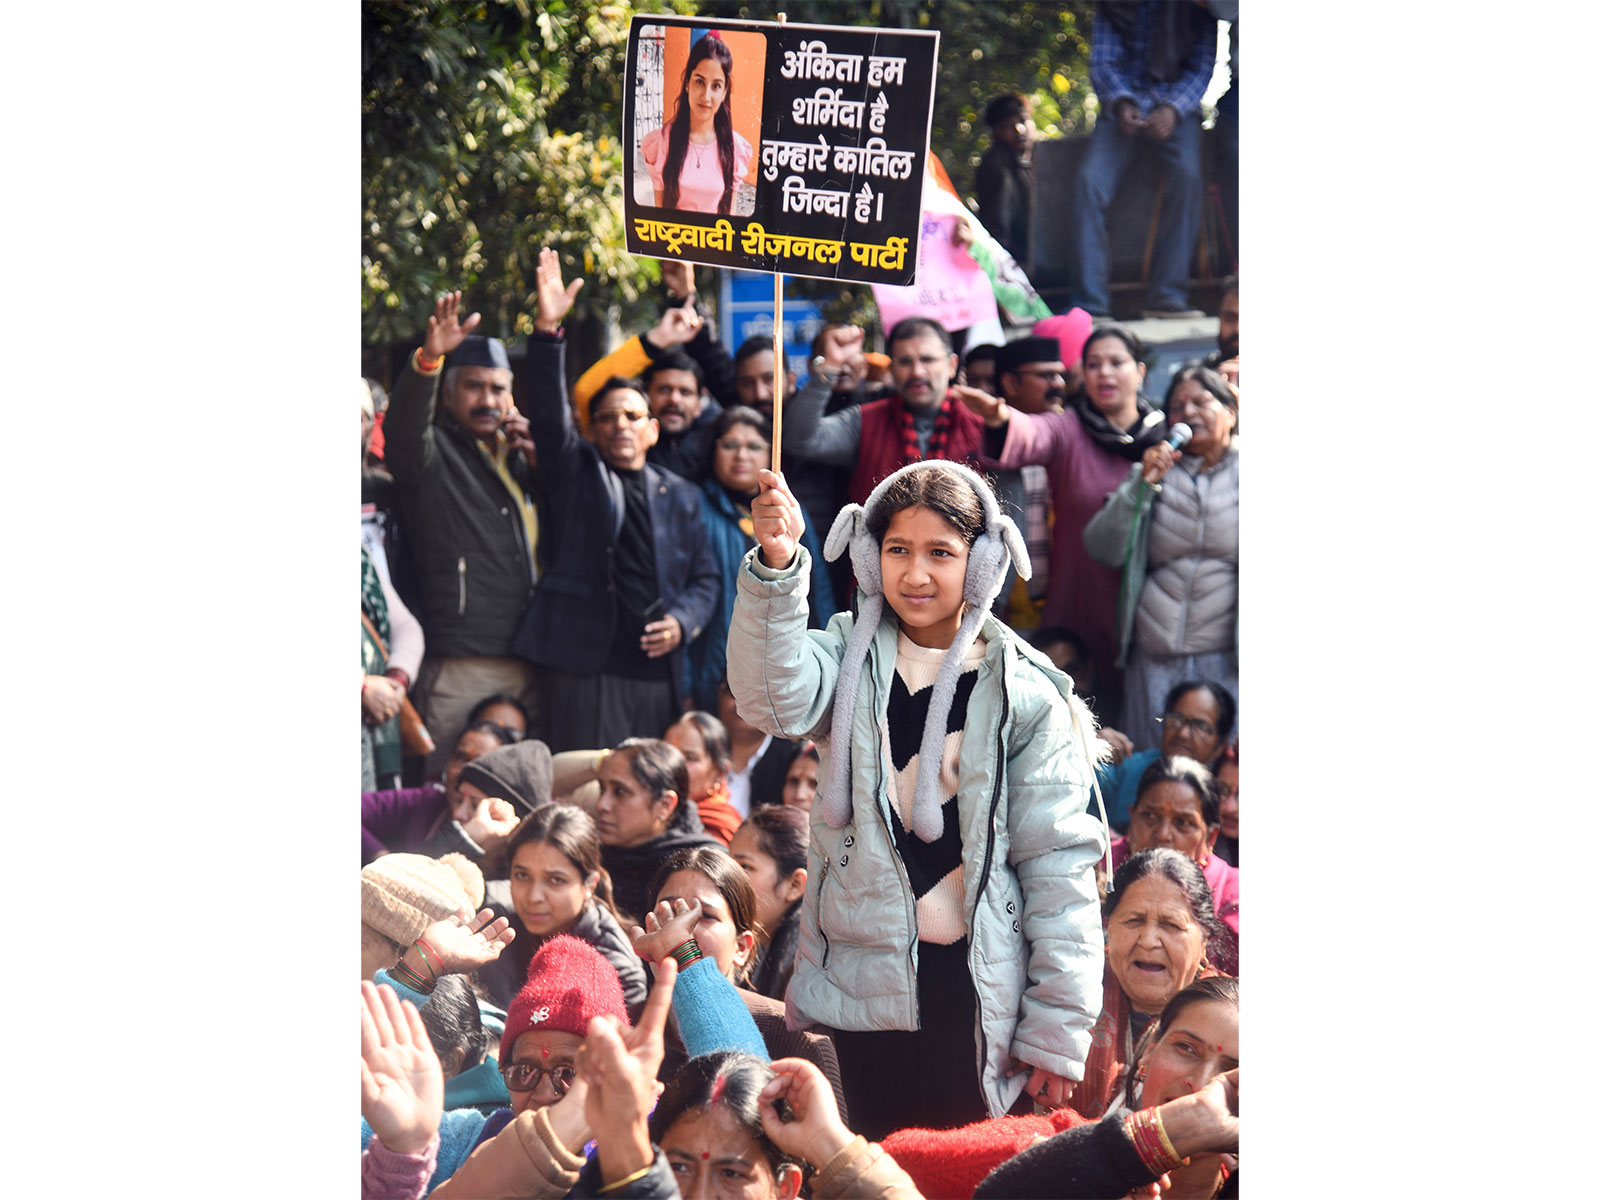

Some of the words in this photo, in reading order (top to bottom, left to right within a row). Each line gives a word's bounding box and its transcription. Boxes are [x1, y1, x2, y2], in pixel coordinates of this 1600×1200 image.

[780, 40, 864, 83] अंकिता
[867, 55, 907, 87] हम
[869, 91, 889, 134] है
[761, 134, 831, 182] तुम्हारे
[833, 137, 915, 180] कातिल
[781, 175, 851, 219] जिन्दा
[633, 218, 736, 255] राष्ट्रवादी
[740, 222, 845, 264] रीजनल
[849, 236, 909, 270] पार्टी
